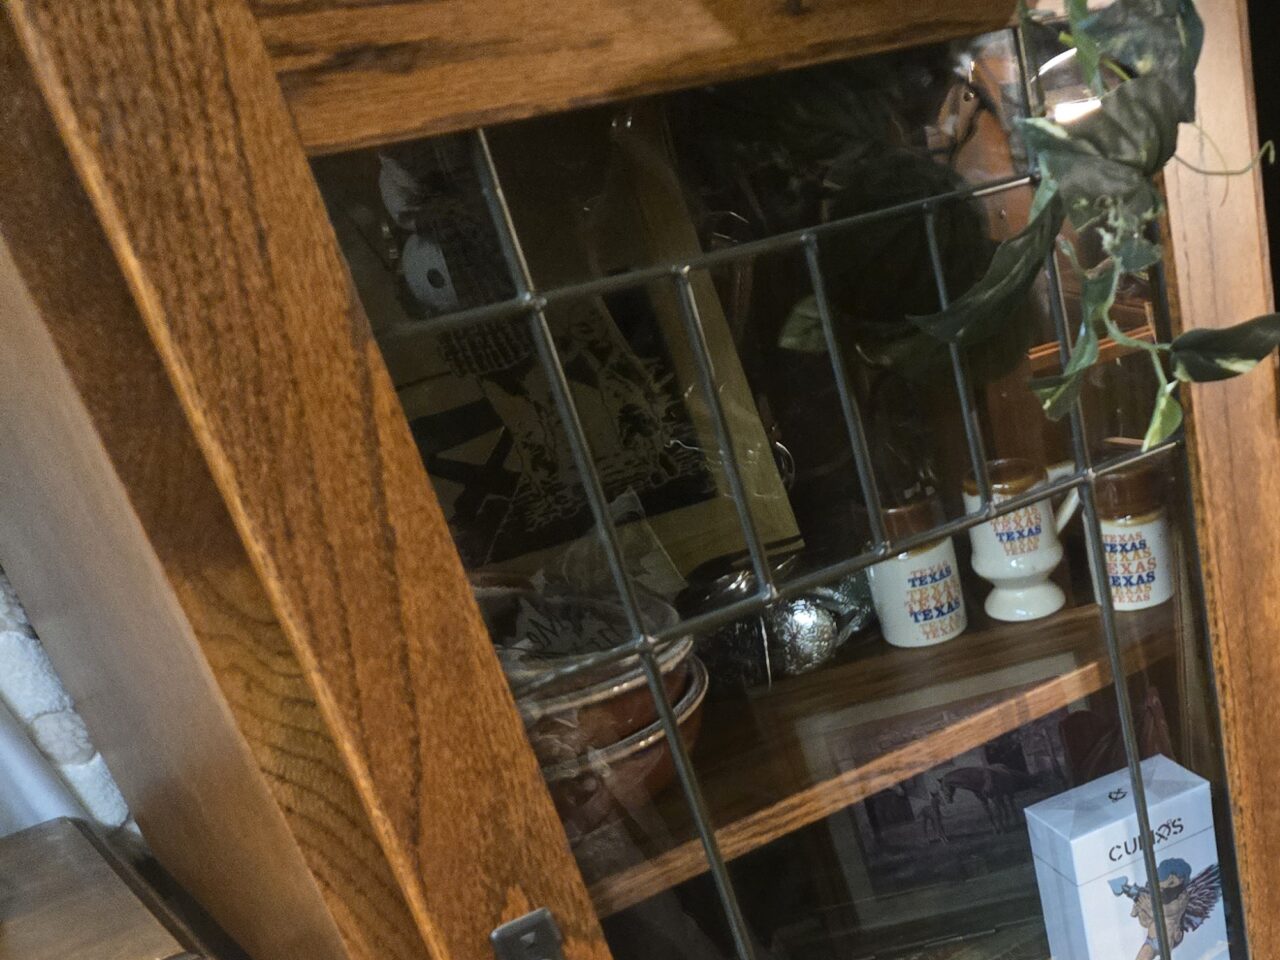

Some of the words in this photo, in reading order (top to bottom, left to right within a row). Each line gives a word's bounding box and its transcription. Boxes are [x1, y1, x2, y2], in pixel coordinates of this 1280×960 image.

[996, 525, 1042, 543] TEXAS
[1105, 547, 1153, 562] EXAS
[1106, 557, 1157, 575] EXAS
[907, 564, 952, 588] TEXAS
[910, 597, 960, 623] TEXAS
